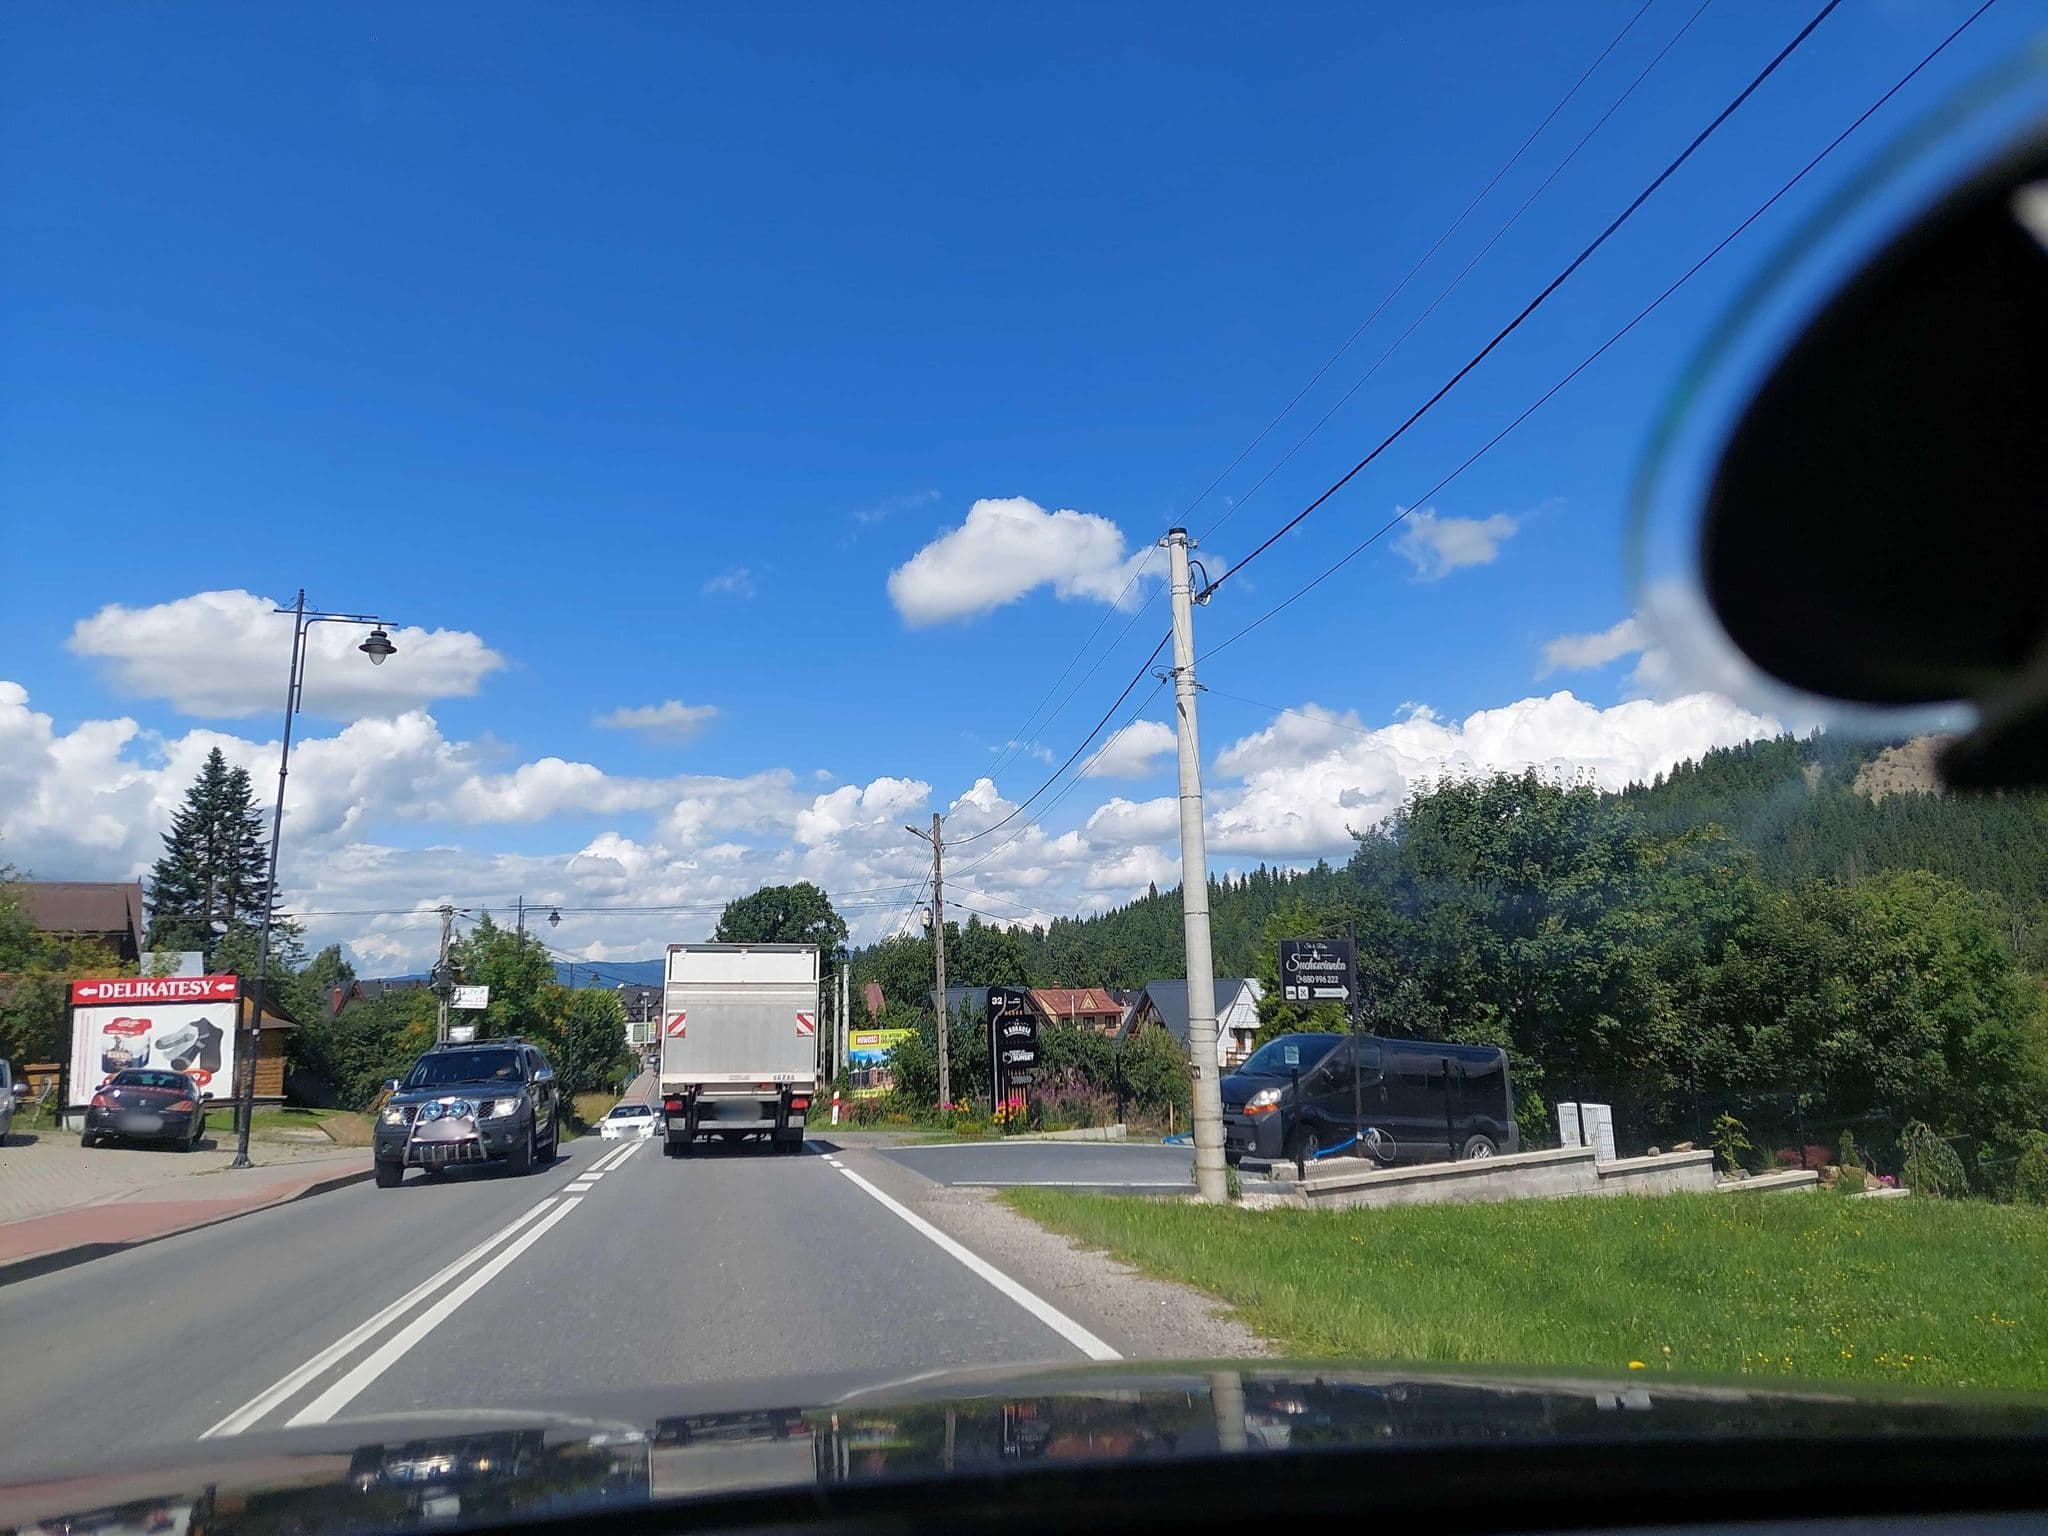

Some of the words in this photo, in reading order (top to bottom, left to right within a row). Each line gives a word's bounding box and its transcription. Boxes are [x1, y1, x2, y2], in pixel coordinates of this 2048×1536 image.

[1302, 975, 1315, 984] 880
[1315, 975, 1327, 984] 996
[1327, 975, 1339, 984] 222
[98, 980, 214, 999] DELIKATESY
[991, 996, 1003, 1005] 32
